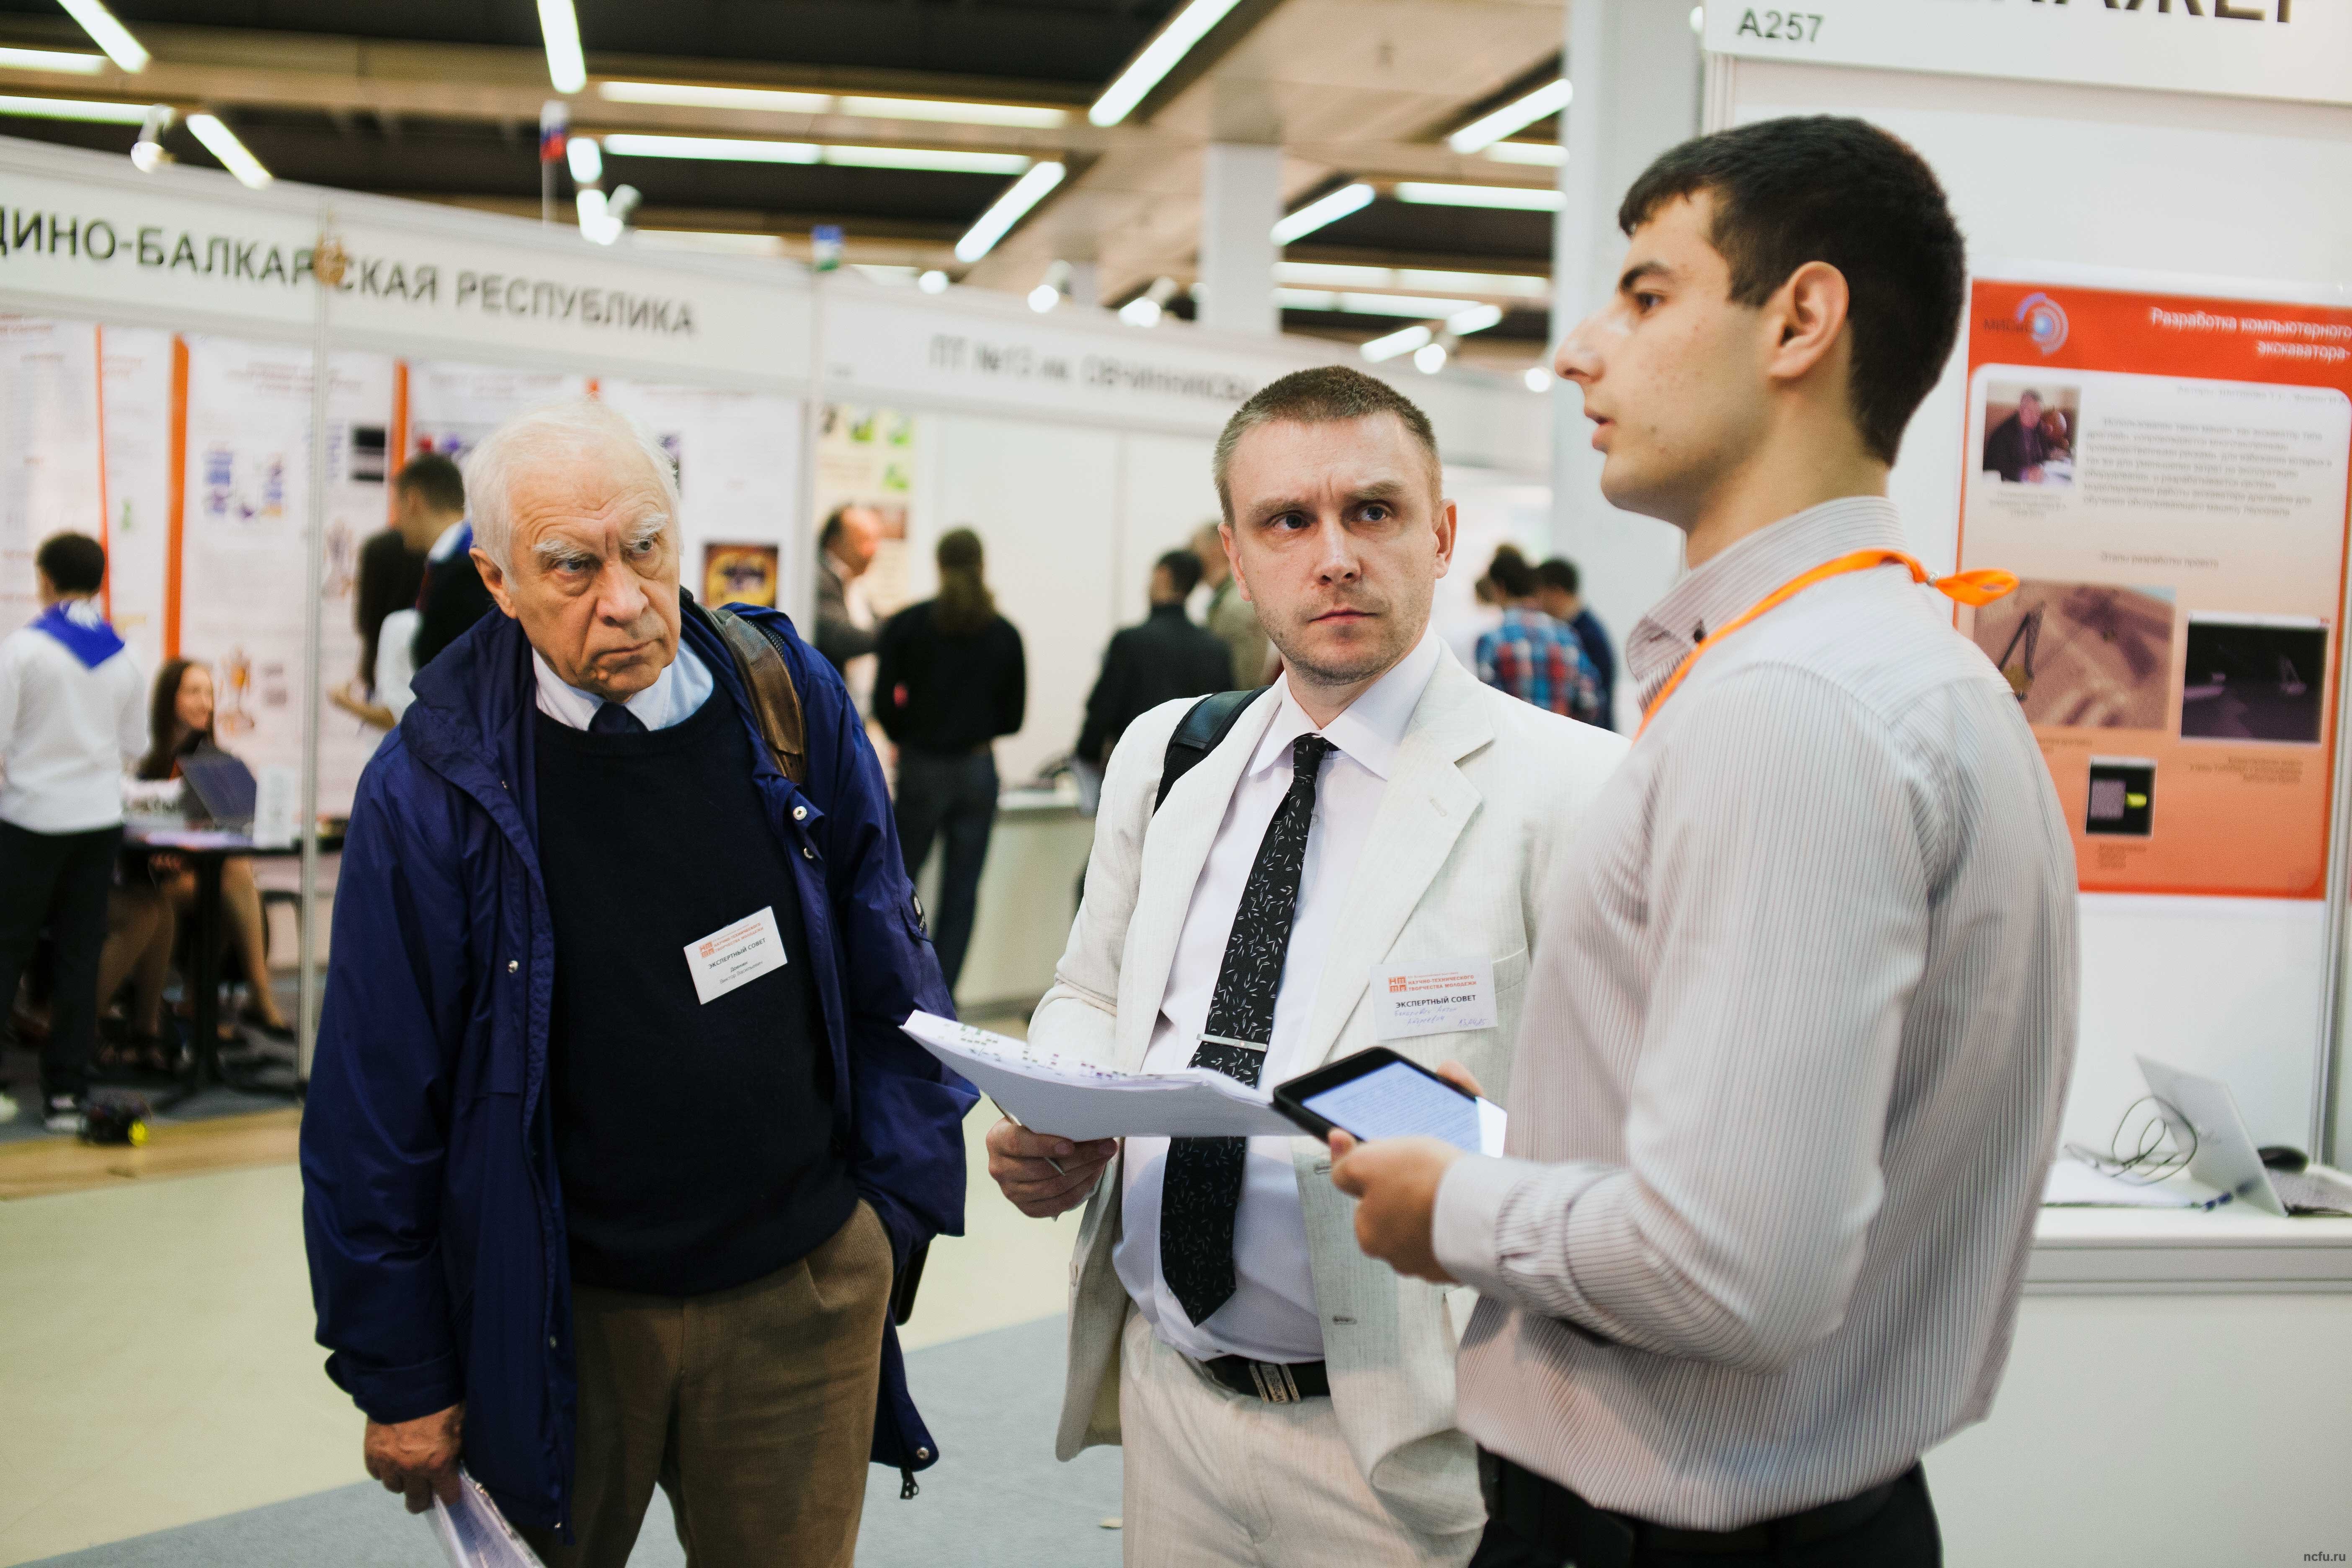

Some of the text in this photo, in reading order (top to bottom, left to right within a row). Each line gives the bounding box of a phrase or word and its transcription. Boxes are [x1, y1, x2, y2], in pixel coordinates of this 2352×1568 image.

[456, 269, 696, 336] РЕСПУБЛИКА
[2151, 306, 2237, 332] Разработка
[709, 938, 766, 969] ЭКСПЕРТНЫЙ СОВЕТ
[1408, 975, 1474, 985] НАУЧНО-ТЕХНИЧЕСКОГО
[1395, 996, 1449, 1008] ЭКСПЕРТНЫЙ
